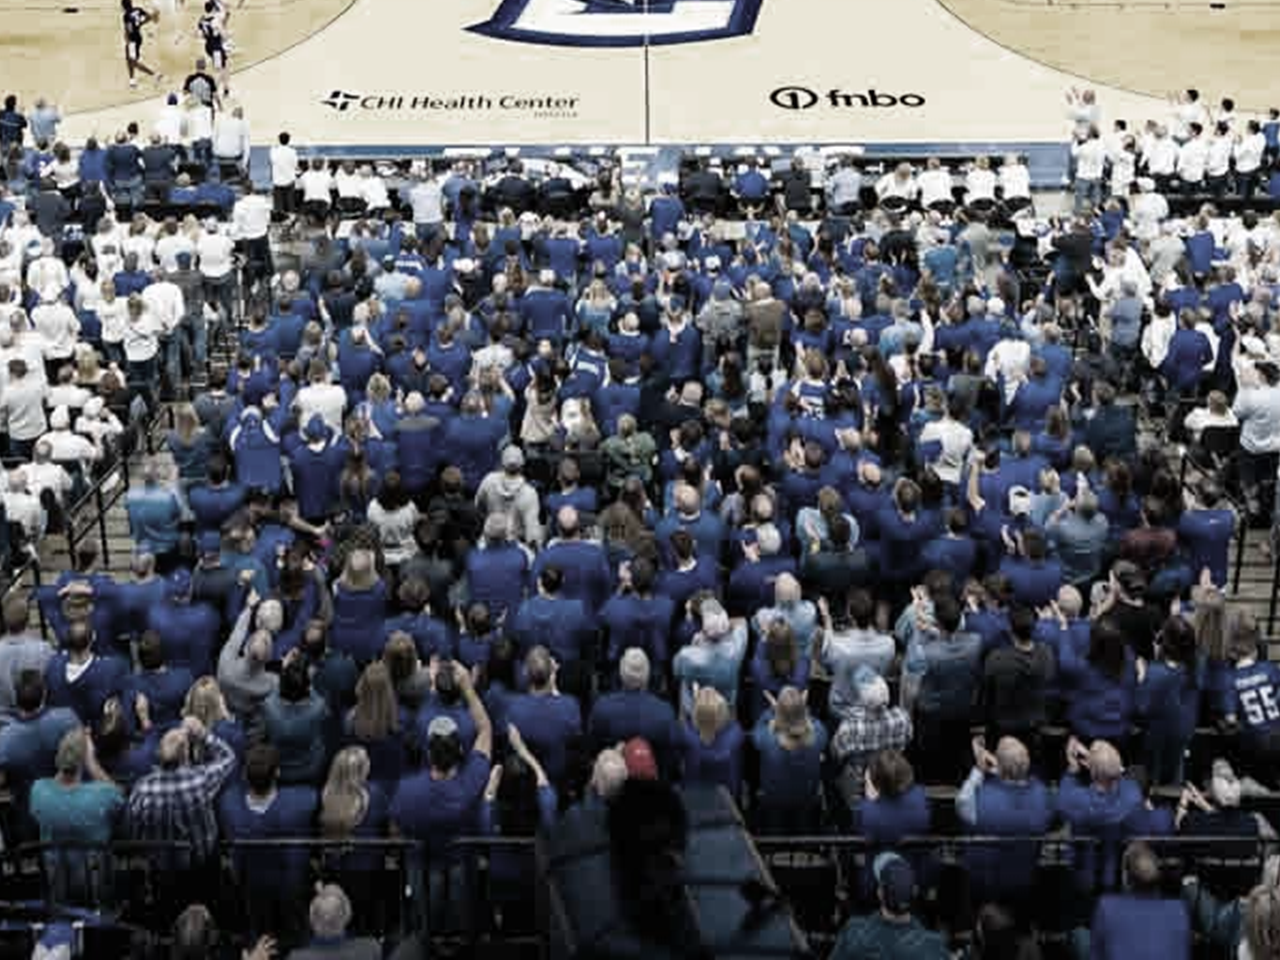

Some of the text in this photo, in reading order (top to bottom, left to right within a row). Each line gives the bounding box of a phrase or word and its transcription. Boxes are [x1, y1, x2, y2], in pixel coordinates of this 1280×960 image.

[360, 94, 580, 111] CHI Health Center
[825, 88, 926, 108] fnbo
[1239, 685, 1280, 725] 55
